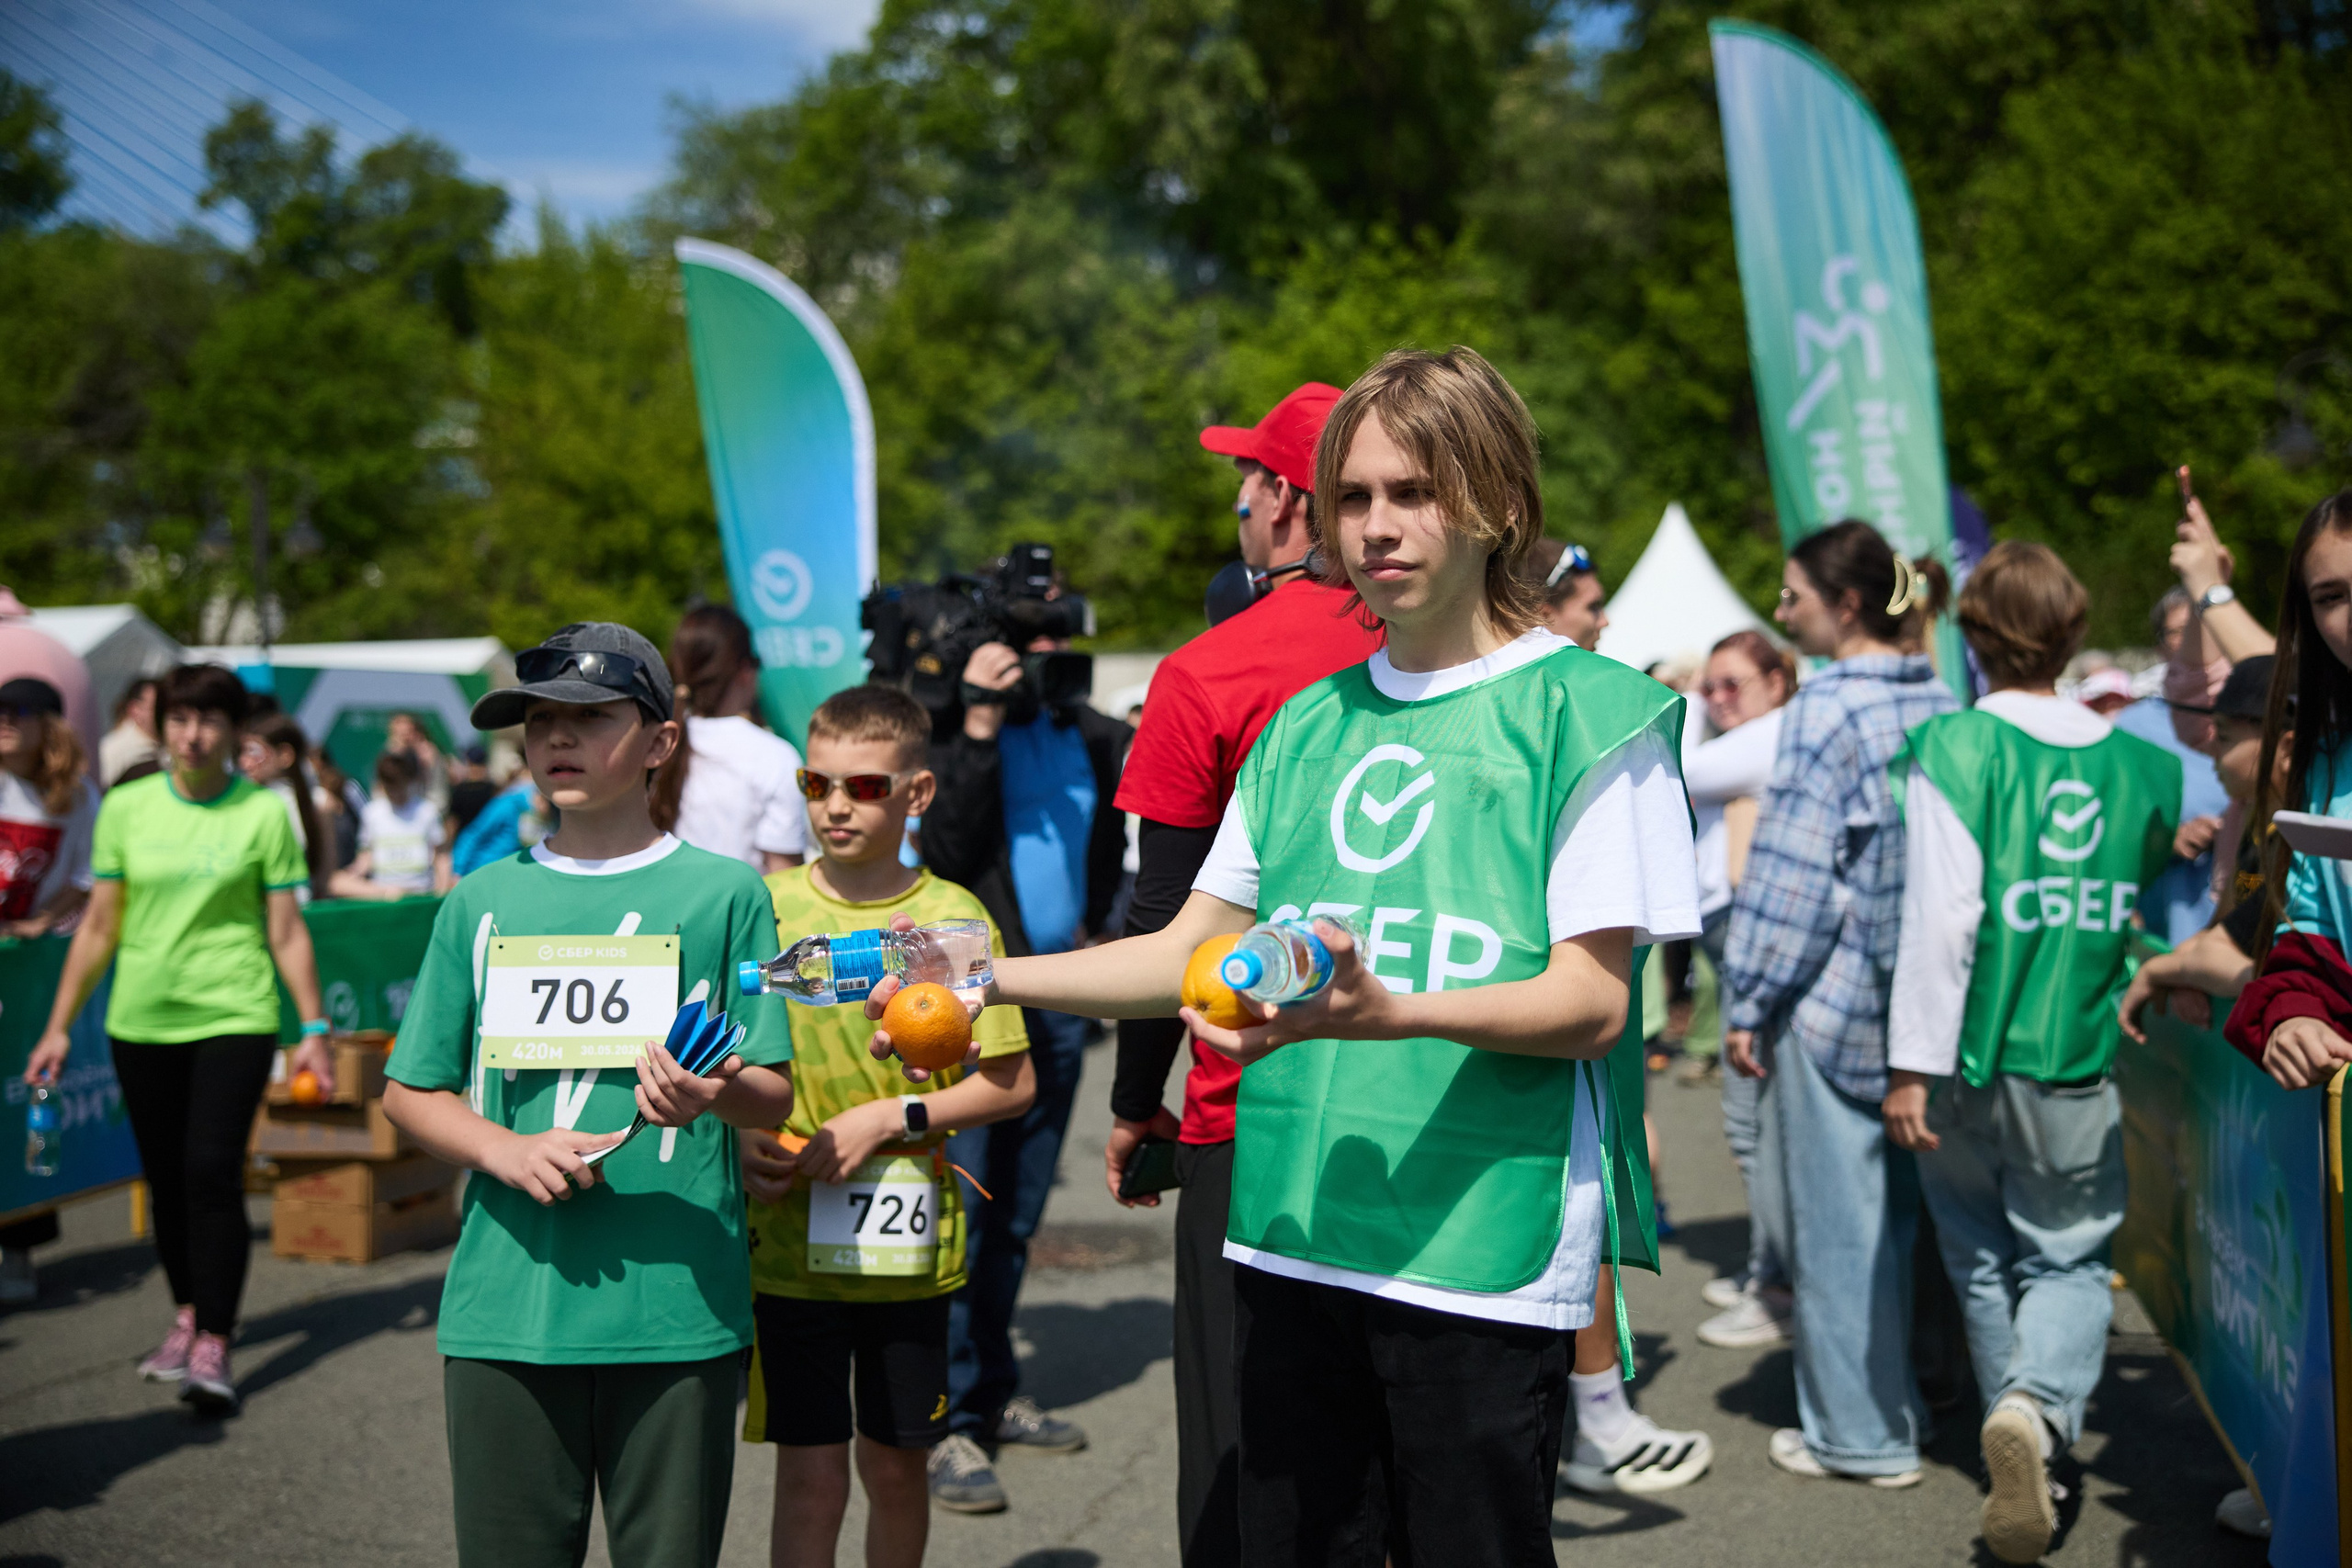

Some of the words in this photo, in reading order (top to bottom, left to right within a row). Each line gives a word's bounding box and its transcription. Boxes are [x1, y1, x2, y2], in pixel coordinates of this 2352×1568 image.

[2001, 875, 2139, 933] СБЕР
[557, 947, 593, 958] СБЕР
[595, 947, 628, 958] KIDS
[1268, 902, 1503, 995] ЕР
[531, 978, 629, 1024] 706
[581, 1044, 641, 1056] 30.05.2026
[848, 1192, 926, 1235] 726
